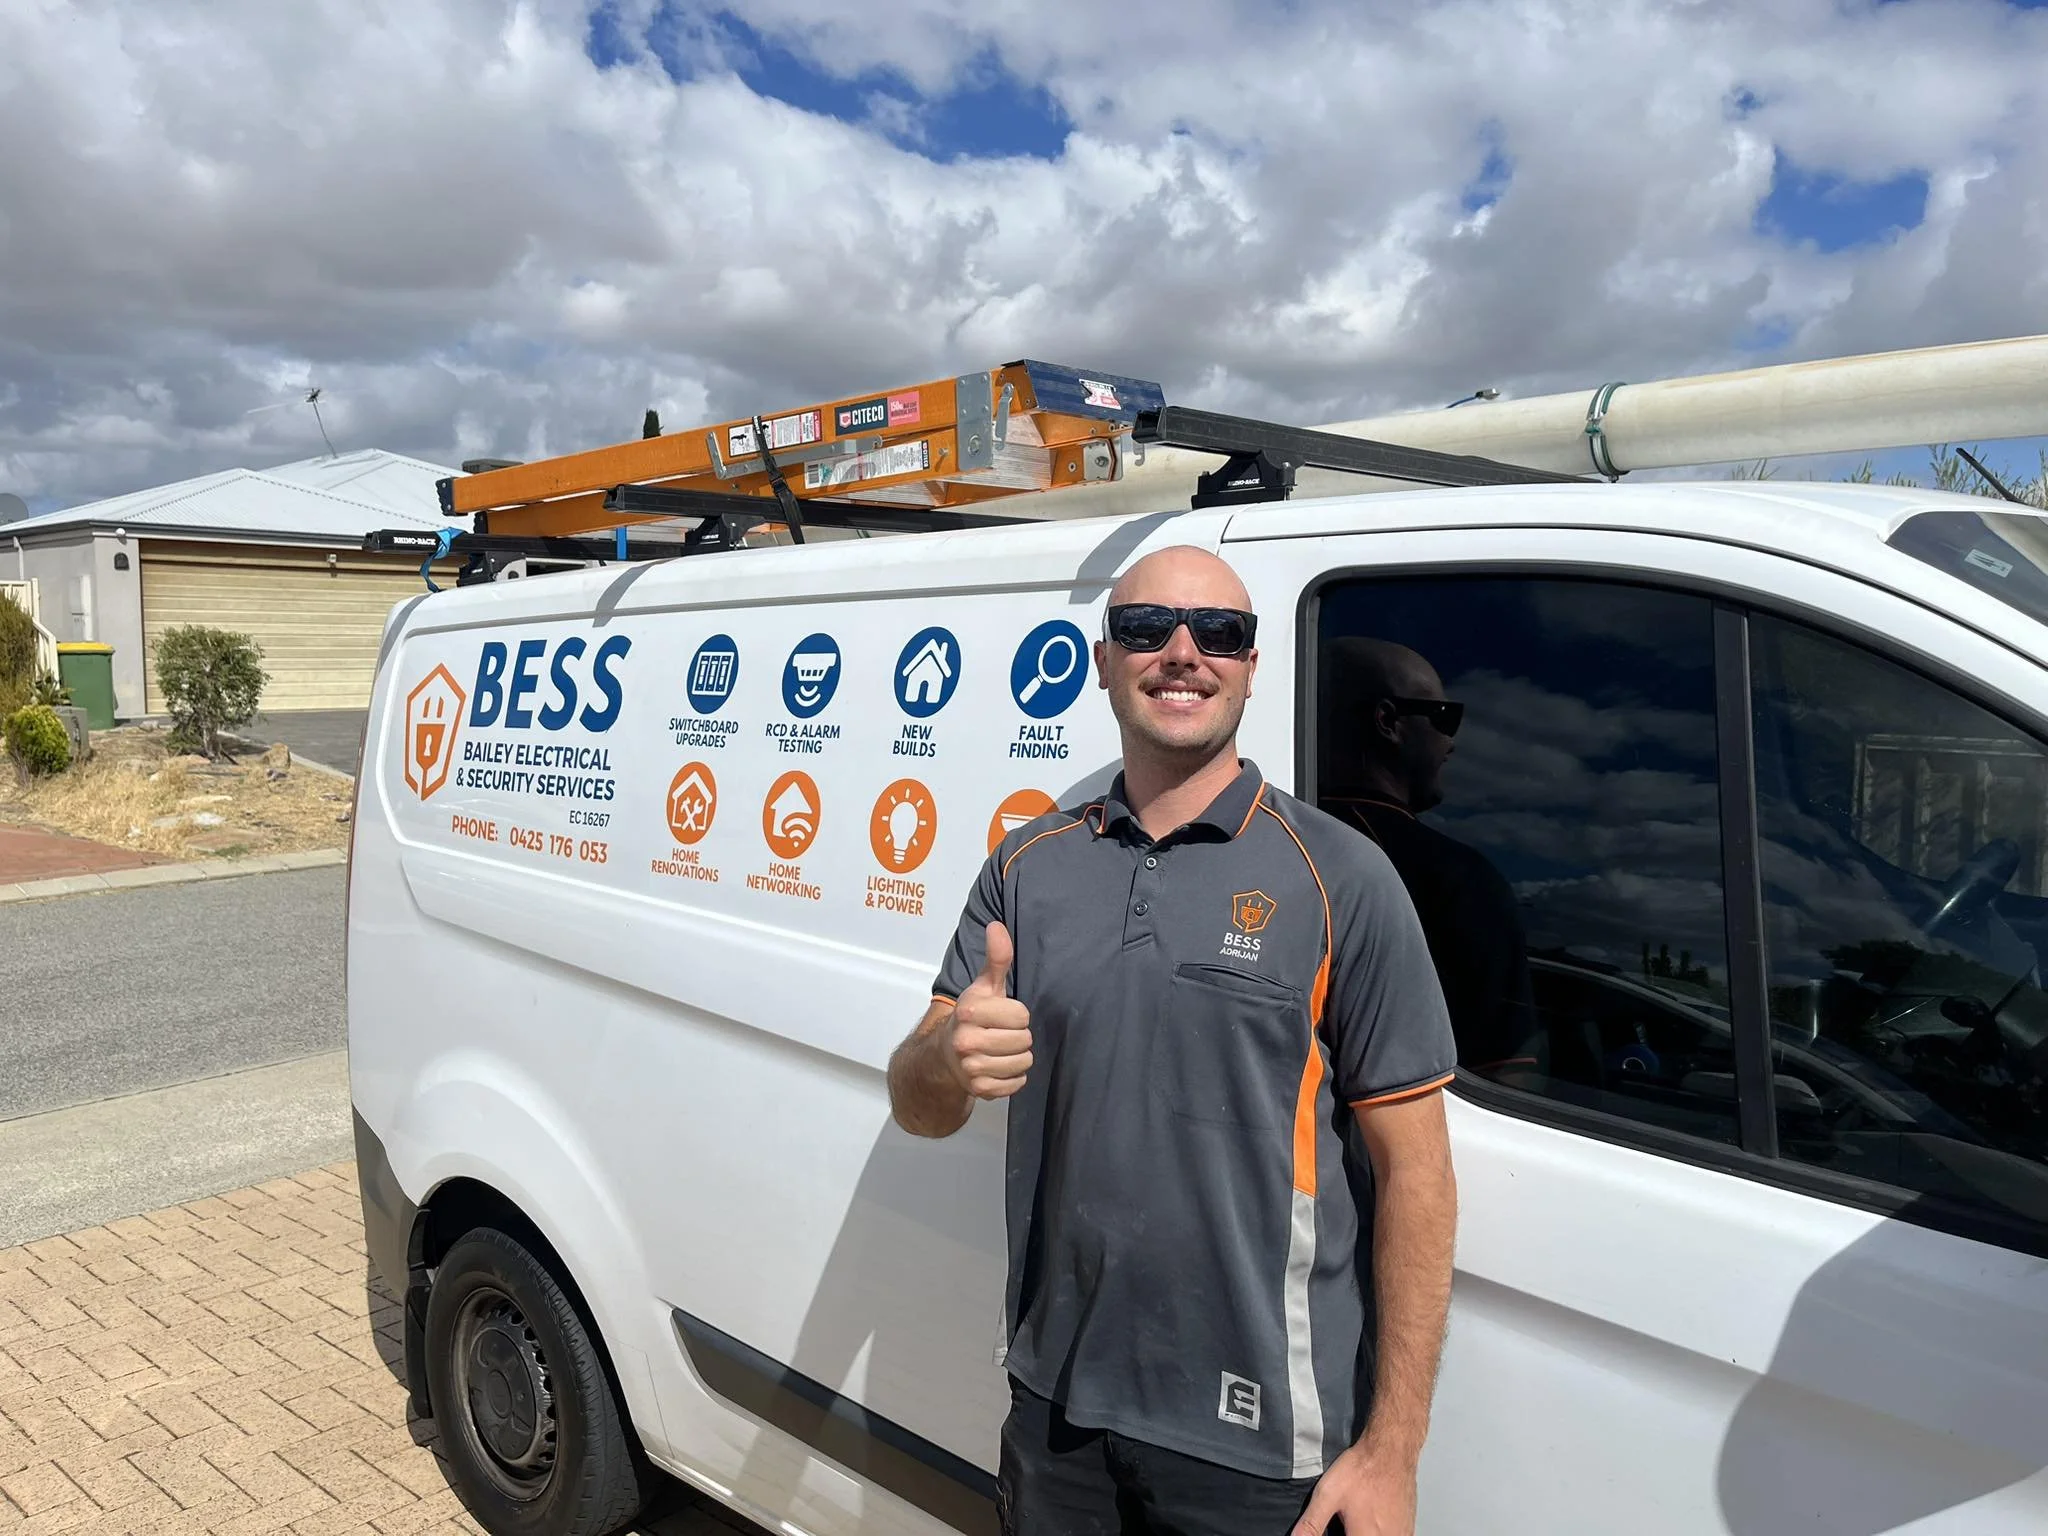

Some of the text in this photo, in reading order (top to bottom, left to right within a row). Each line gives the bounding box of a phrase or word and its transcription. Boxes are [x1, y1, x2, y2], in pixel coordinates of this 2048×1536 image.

[852, 404, 884, 426] CITECO
[468, 634, 633, 733] BESS
[668, 717, 739, 734] SWITCHBOARD
[765, 723, 841, 739] RCD & ALARM
[901, 724, 933, 741] NEW
[1018, 725, 1064, 742] FAULT
[675, 733, 726, 748] UPGRADES
[778, 739, 823, 754] TESTING
[892, 740, 936, 757] BUILDS
[463, 741, 612, 771] BAILEY ELECTRICAL
[1009, 742, 1069, 760] FINDING
[456, 767, 616, 801] & SECURITY SERVICES
[451, 815, 608, 864] PHONE: 0425 176 053
[671, 847, 700, 864] HOME
[651, 859, 719, 883] RENOVATIONS
[768, 862, 801, 881] HOME
[746, 874, 822, 901] NETWORKING
[867, 875, 925, 898] LIGHTING
[865, 892, 923, 916] & POWER
[1223, 932, 1262, 951] BESS
[1219, 946, 1259, 961] ADRIJAN
